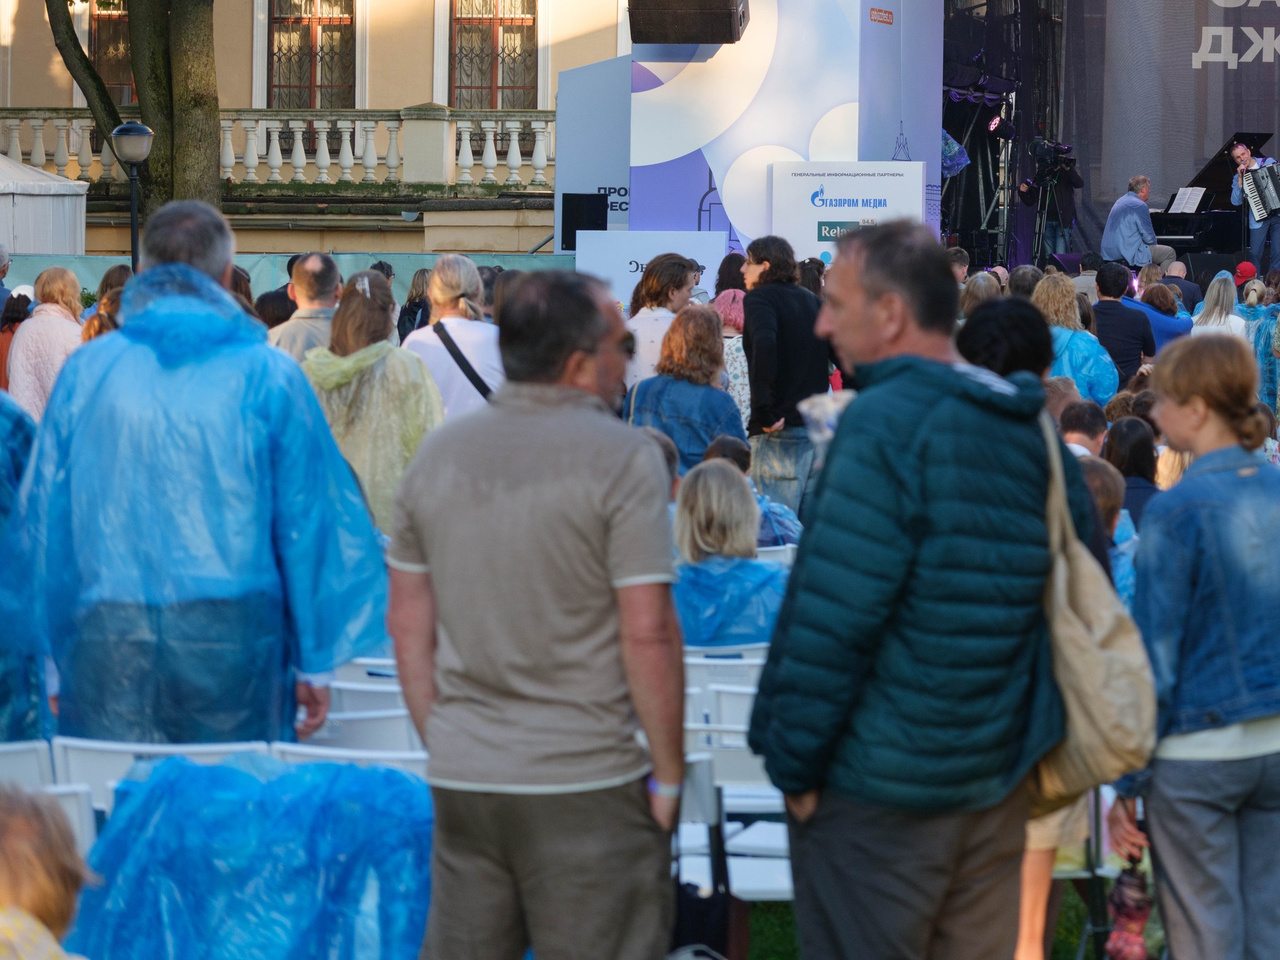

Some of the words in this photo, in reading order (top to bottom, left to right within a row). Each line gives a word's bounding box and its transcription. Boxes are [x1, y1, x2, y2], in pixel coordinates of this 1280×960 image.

[597, 187, 630, 197] ПРО
[825, 198, 859, 208] ГАЗПРОМ
[861, 198, 887, 209] МЕДИА
